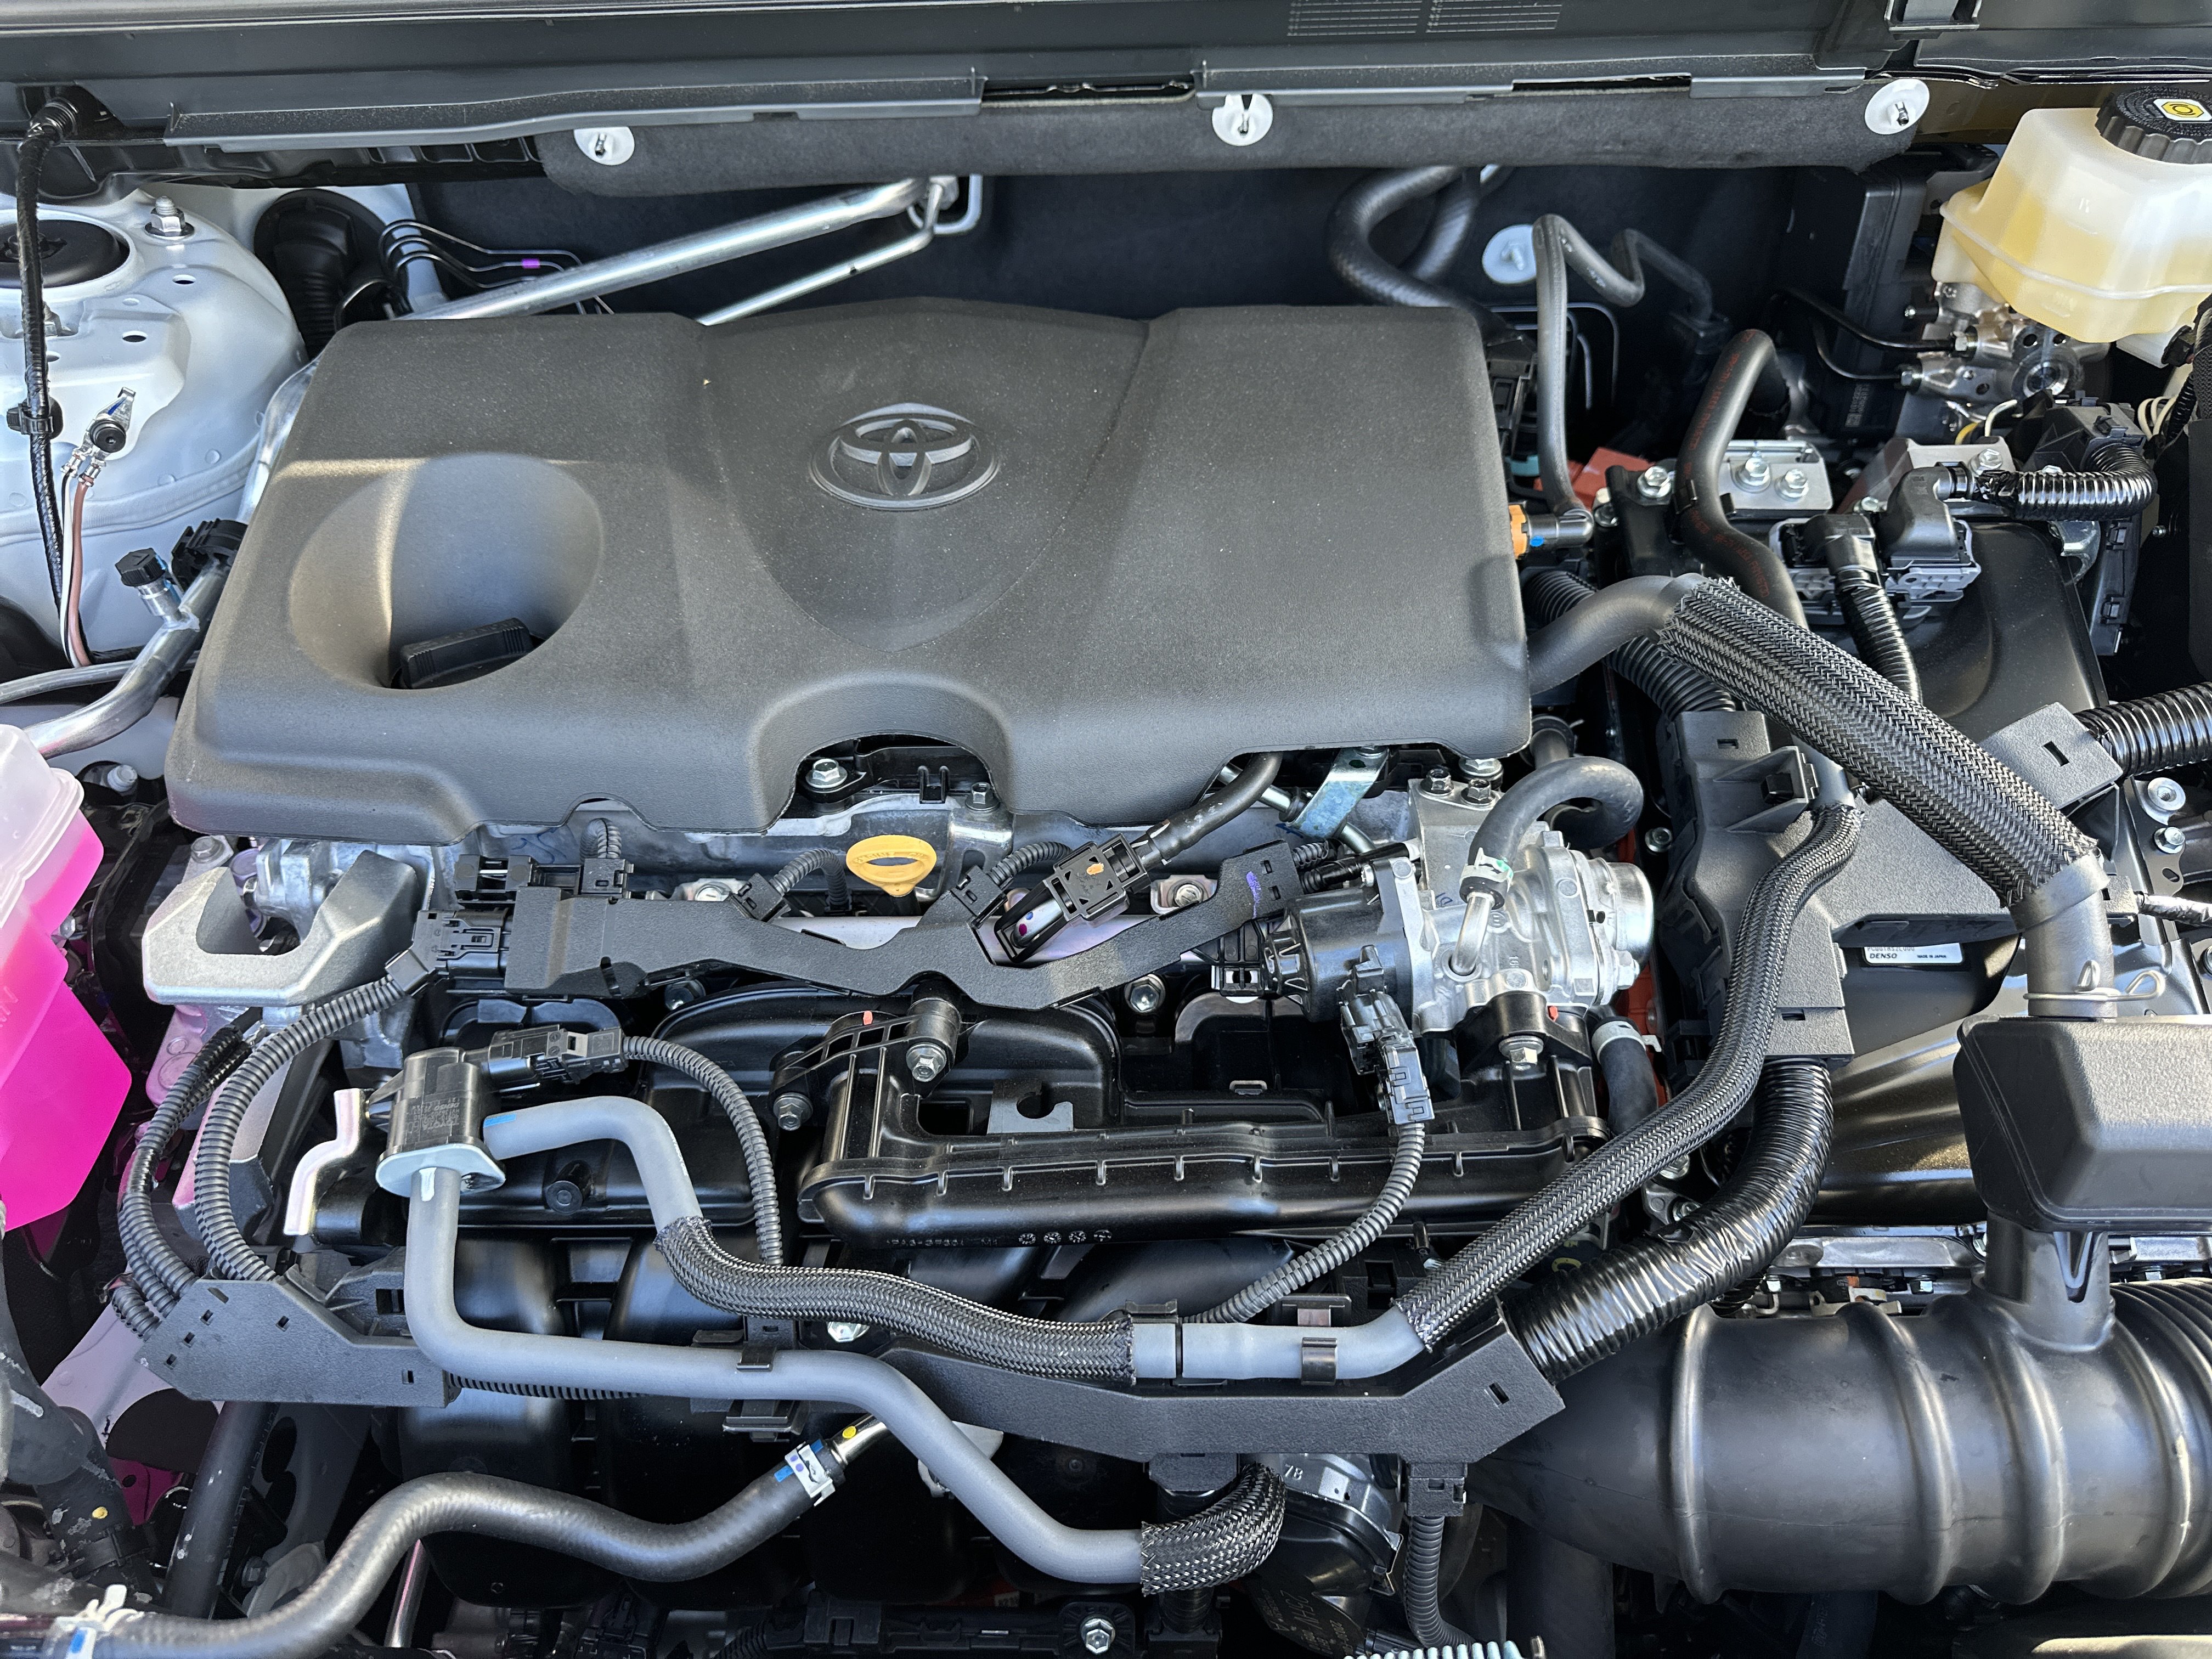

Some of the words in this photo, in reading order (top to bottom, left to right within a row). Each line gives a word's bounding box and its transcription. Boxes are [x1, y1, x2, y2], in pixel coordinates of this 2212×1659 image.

[433, 1102, 460, 1111] DENSO
[422, 1119, 459, 1130] TOYOTA
[1285, 1463, 1303, 1480] 78
[1279, 1589, 1324, 1630] 25HV
